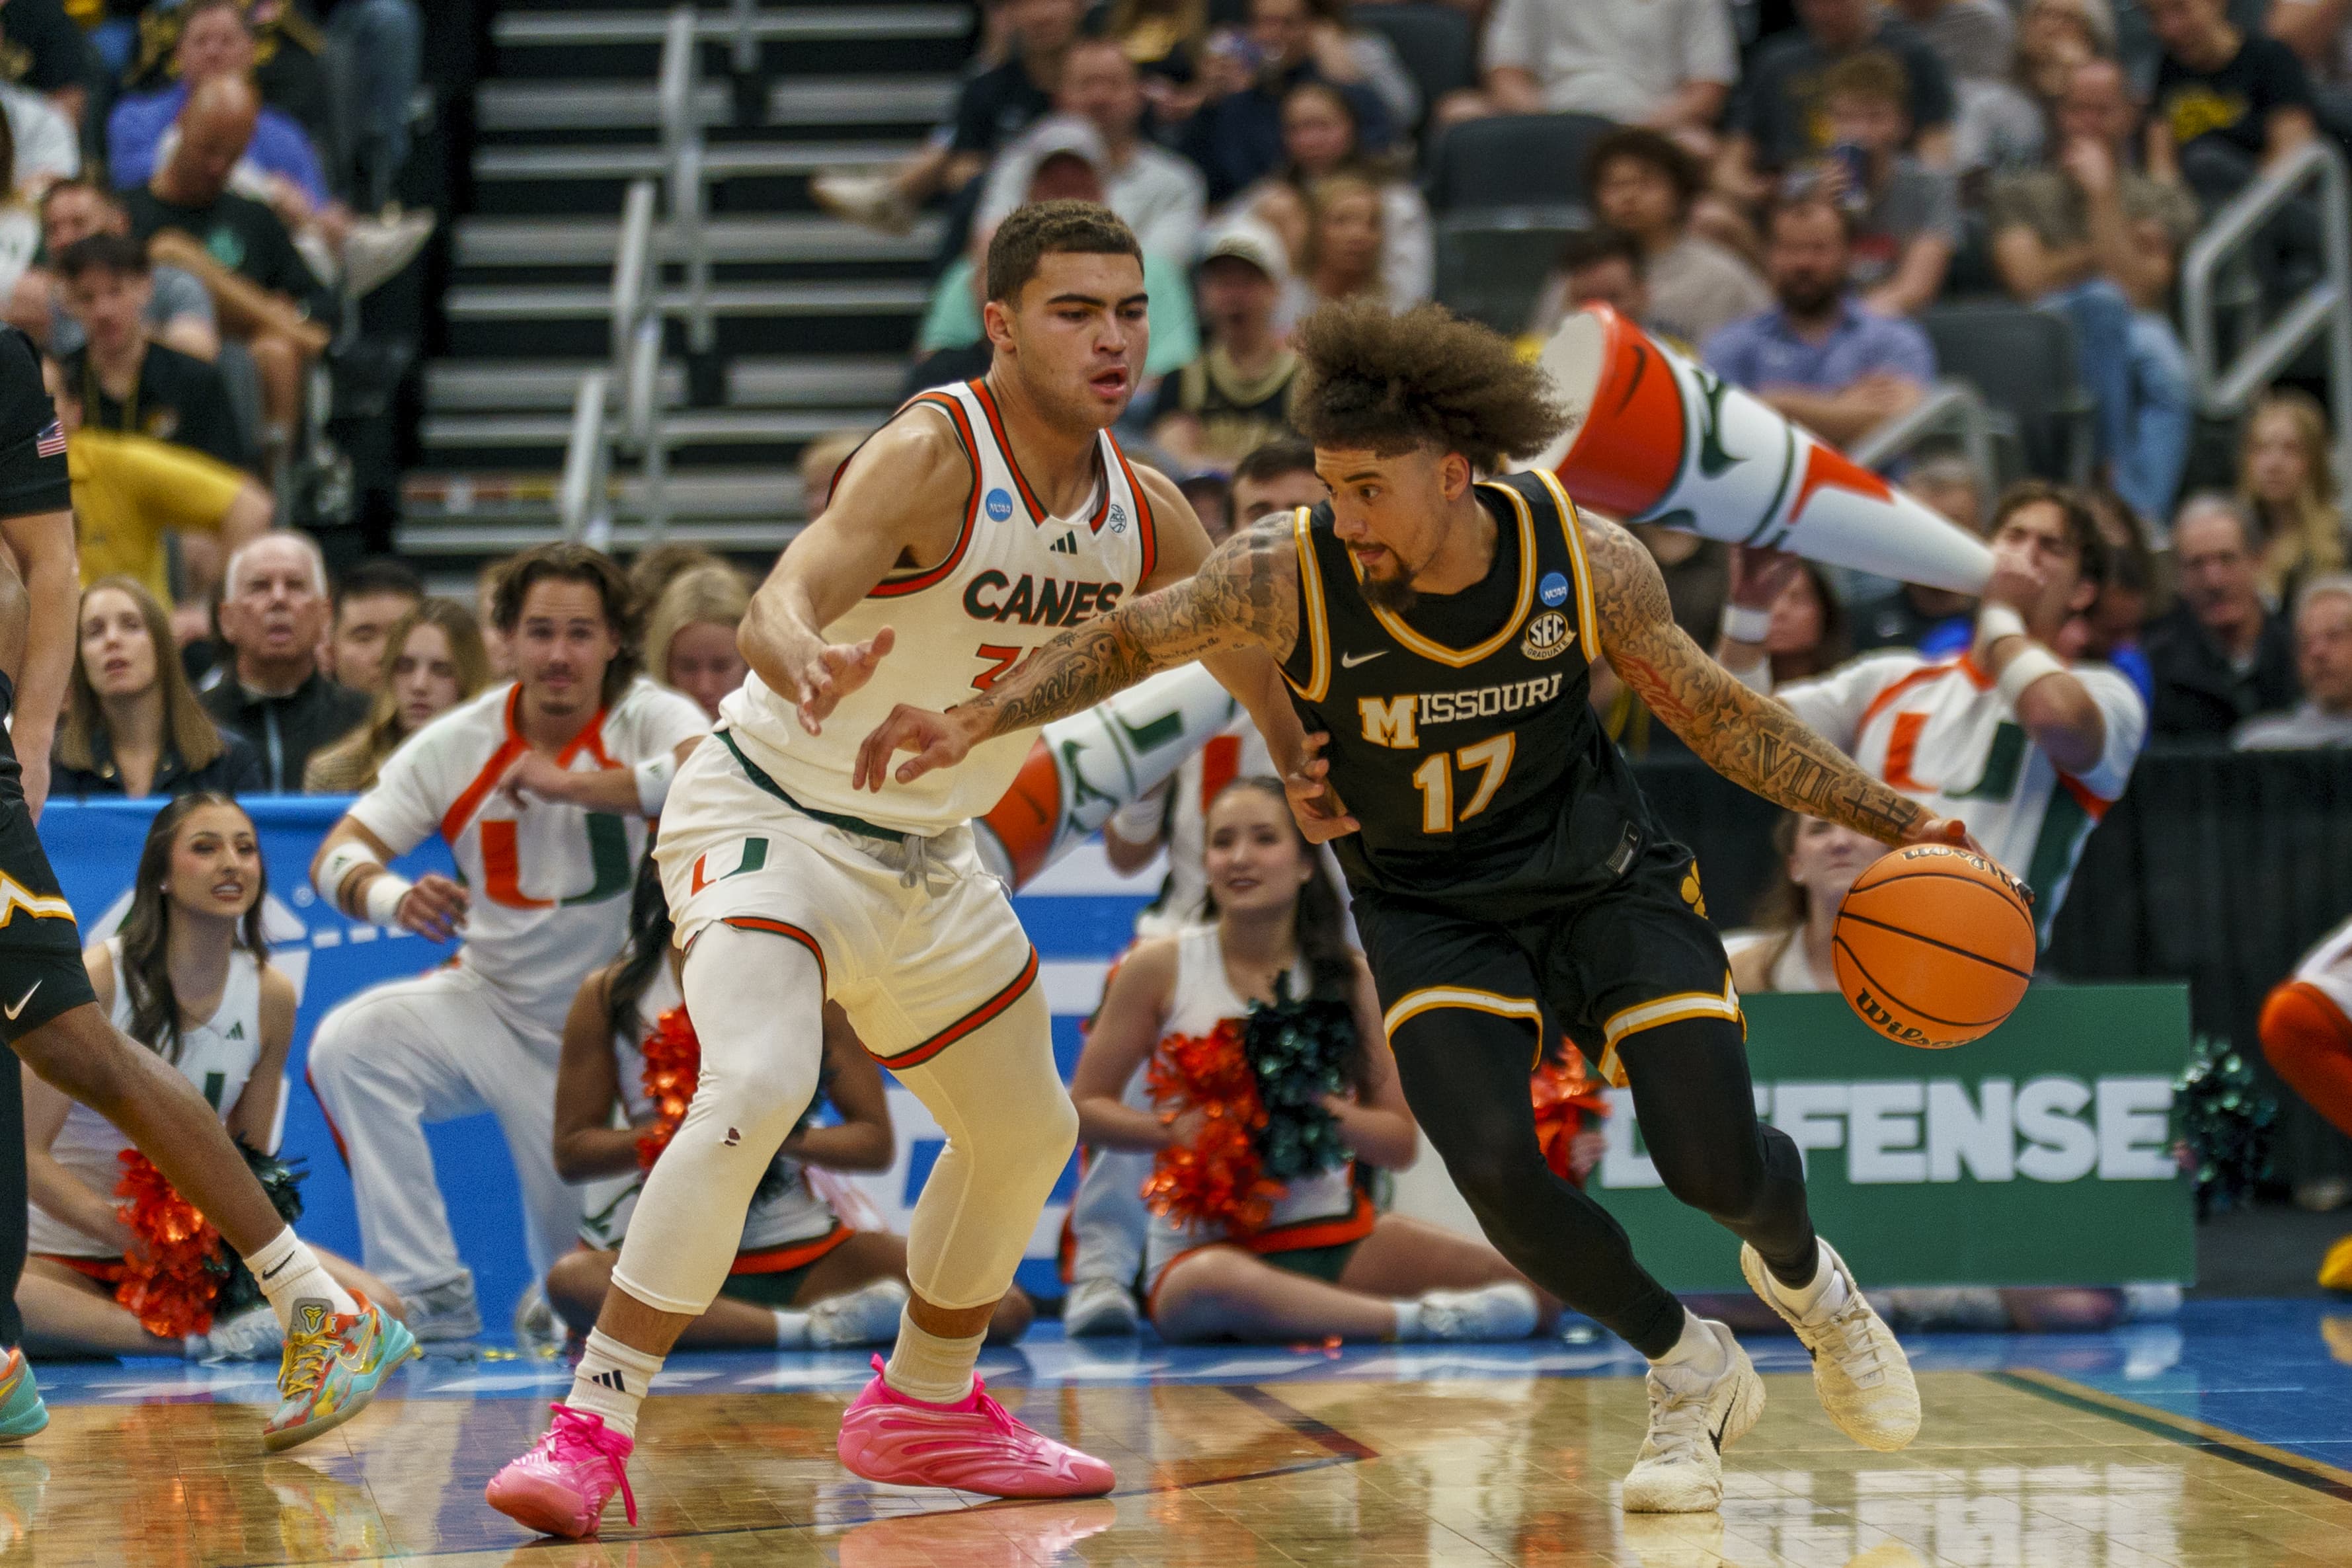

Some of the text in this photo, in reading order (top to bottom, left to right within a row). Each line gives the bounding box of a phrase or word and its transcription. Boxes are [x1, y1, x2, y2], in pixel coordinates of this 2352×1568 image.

[962, 569, 1124, 628] CANES
[1544, 586, 1567, 600] NCAA
[1527, 639, 1569, 658] GRADUATE
[1529, 613, 1564, 648] SEC
[1358, 673, 1563, 749] MISSOURI
[1413, 731, 1516, 834] 17
